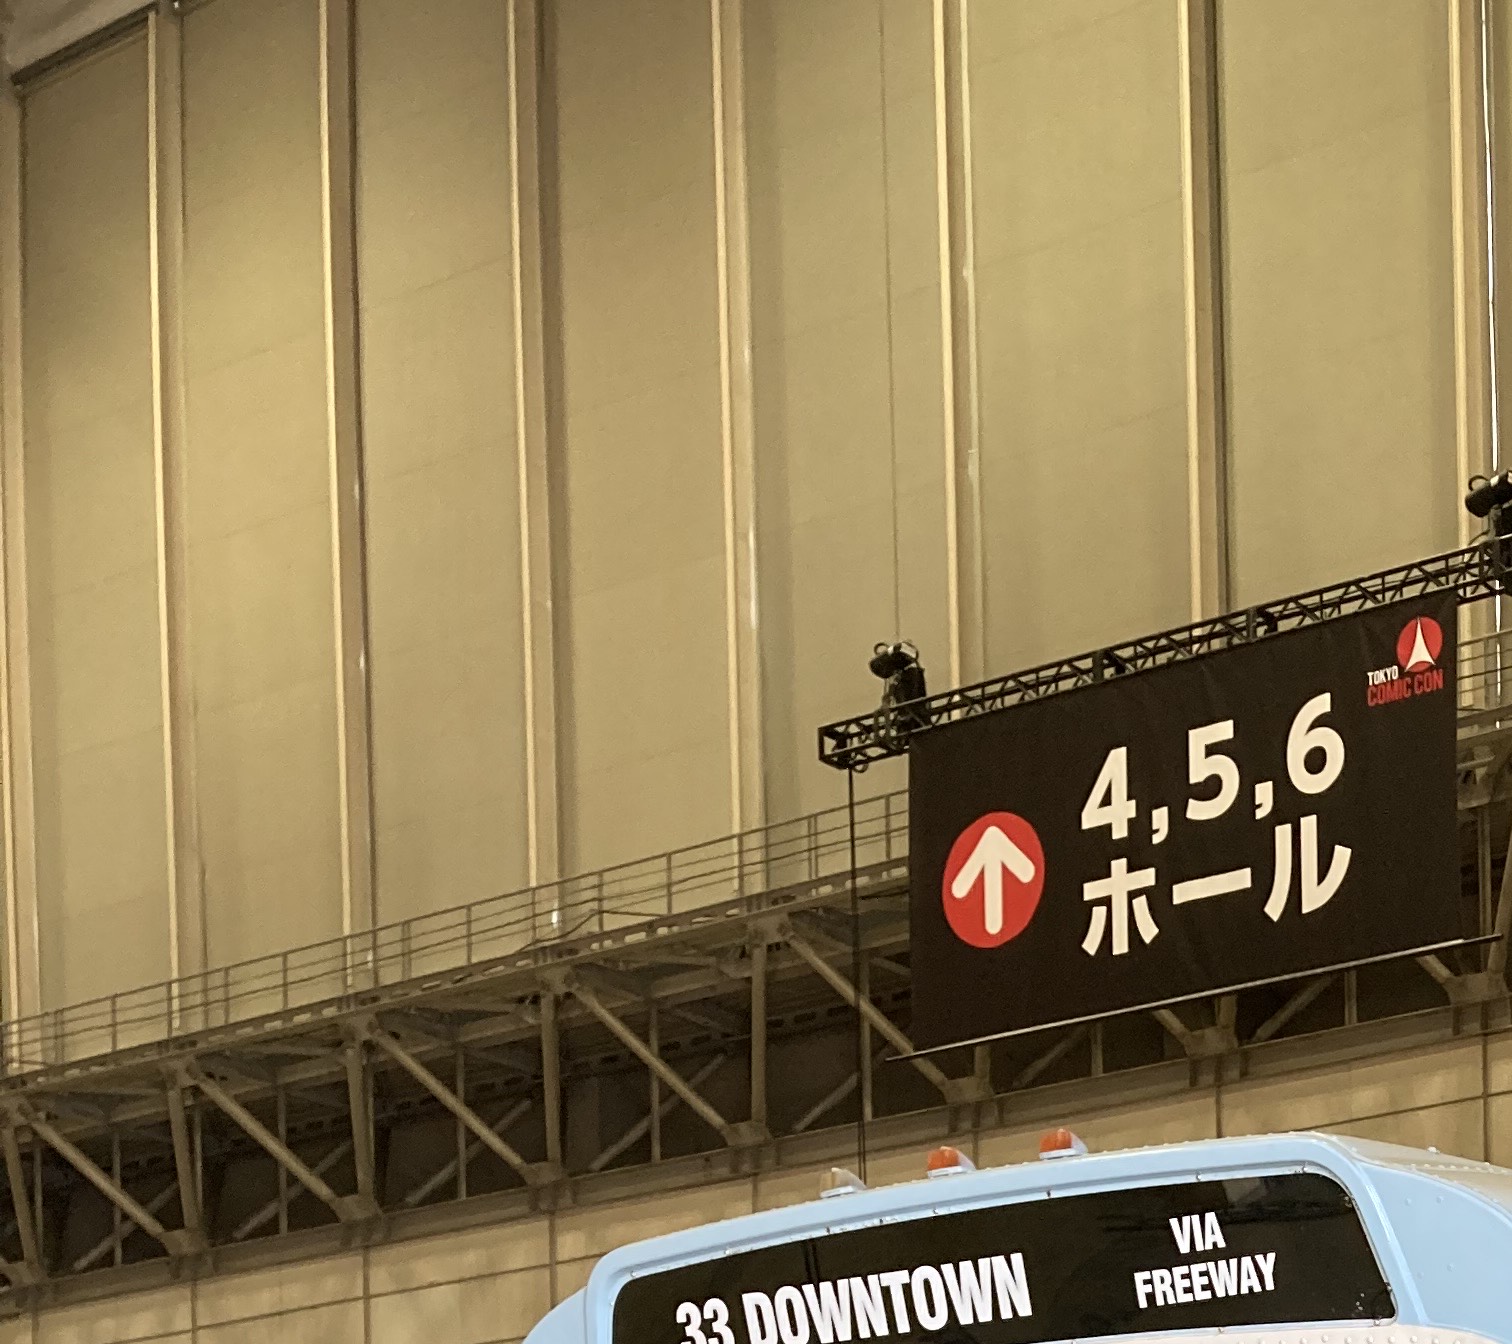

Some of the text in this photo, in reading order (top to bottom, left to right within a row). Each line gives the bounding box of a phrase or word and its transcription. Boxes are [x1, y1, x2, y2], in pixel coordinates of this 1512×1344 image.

[1367, 665, 1399, 686] TOKYO
[1367, 669, 1444, 707] COMIC CON
[1081, 692, 1345, 845] 4,5,6
[1081, 814, 1352, 956] ホール
[1169, 1211, 1226, 1254] VIA
[1134, 1252, 1276, 1309] FREEWAY
